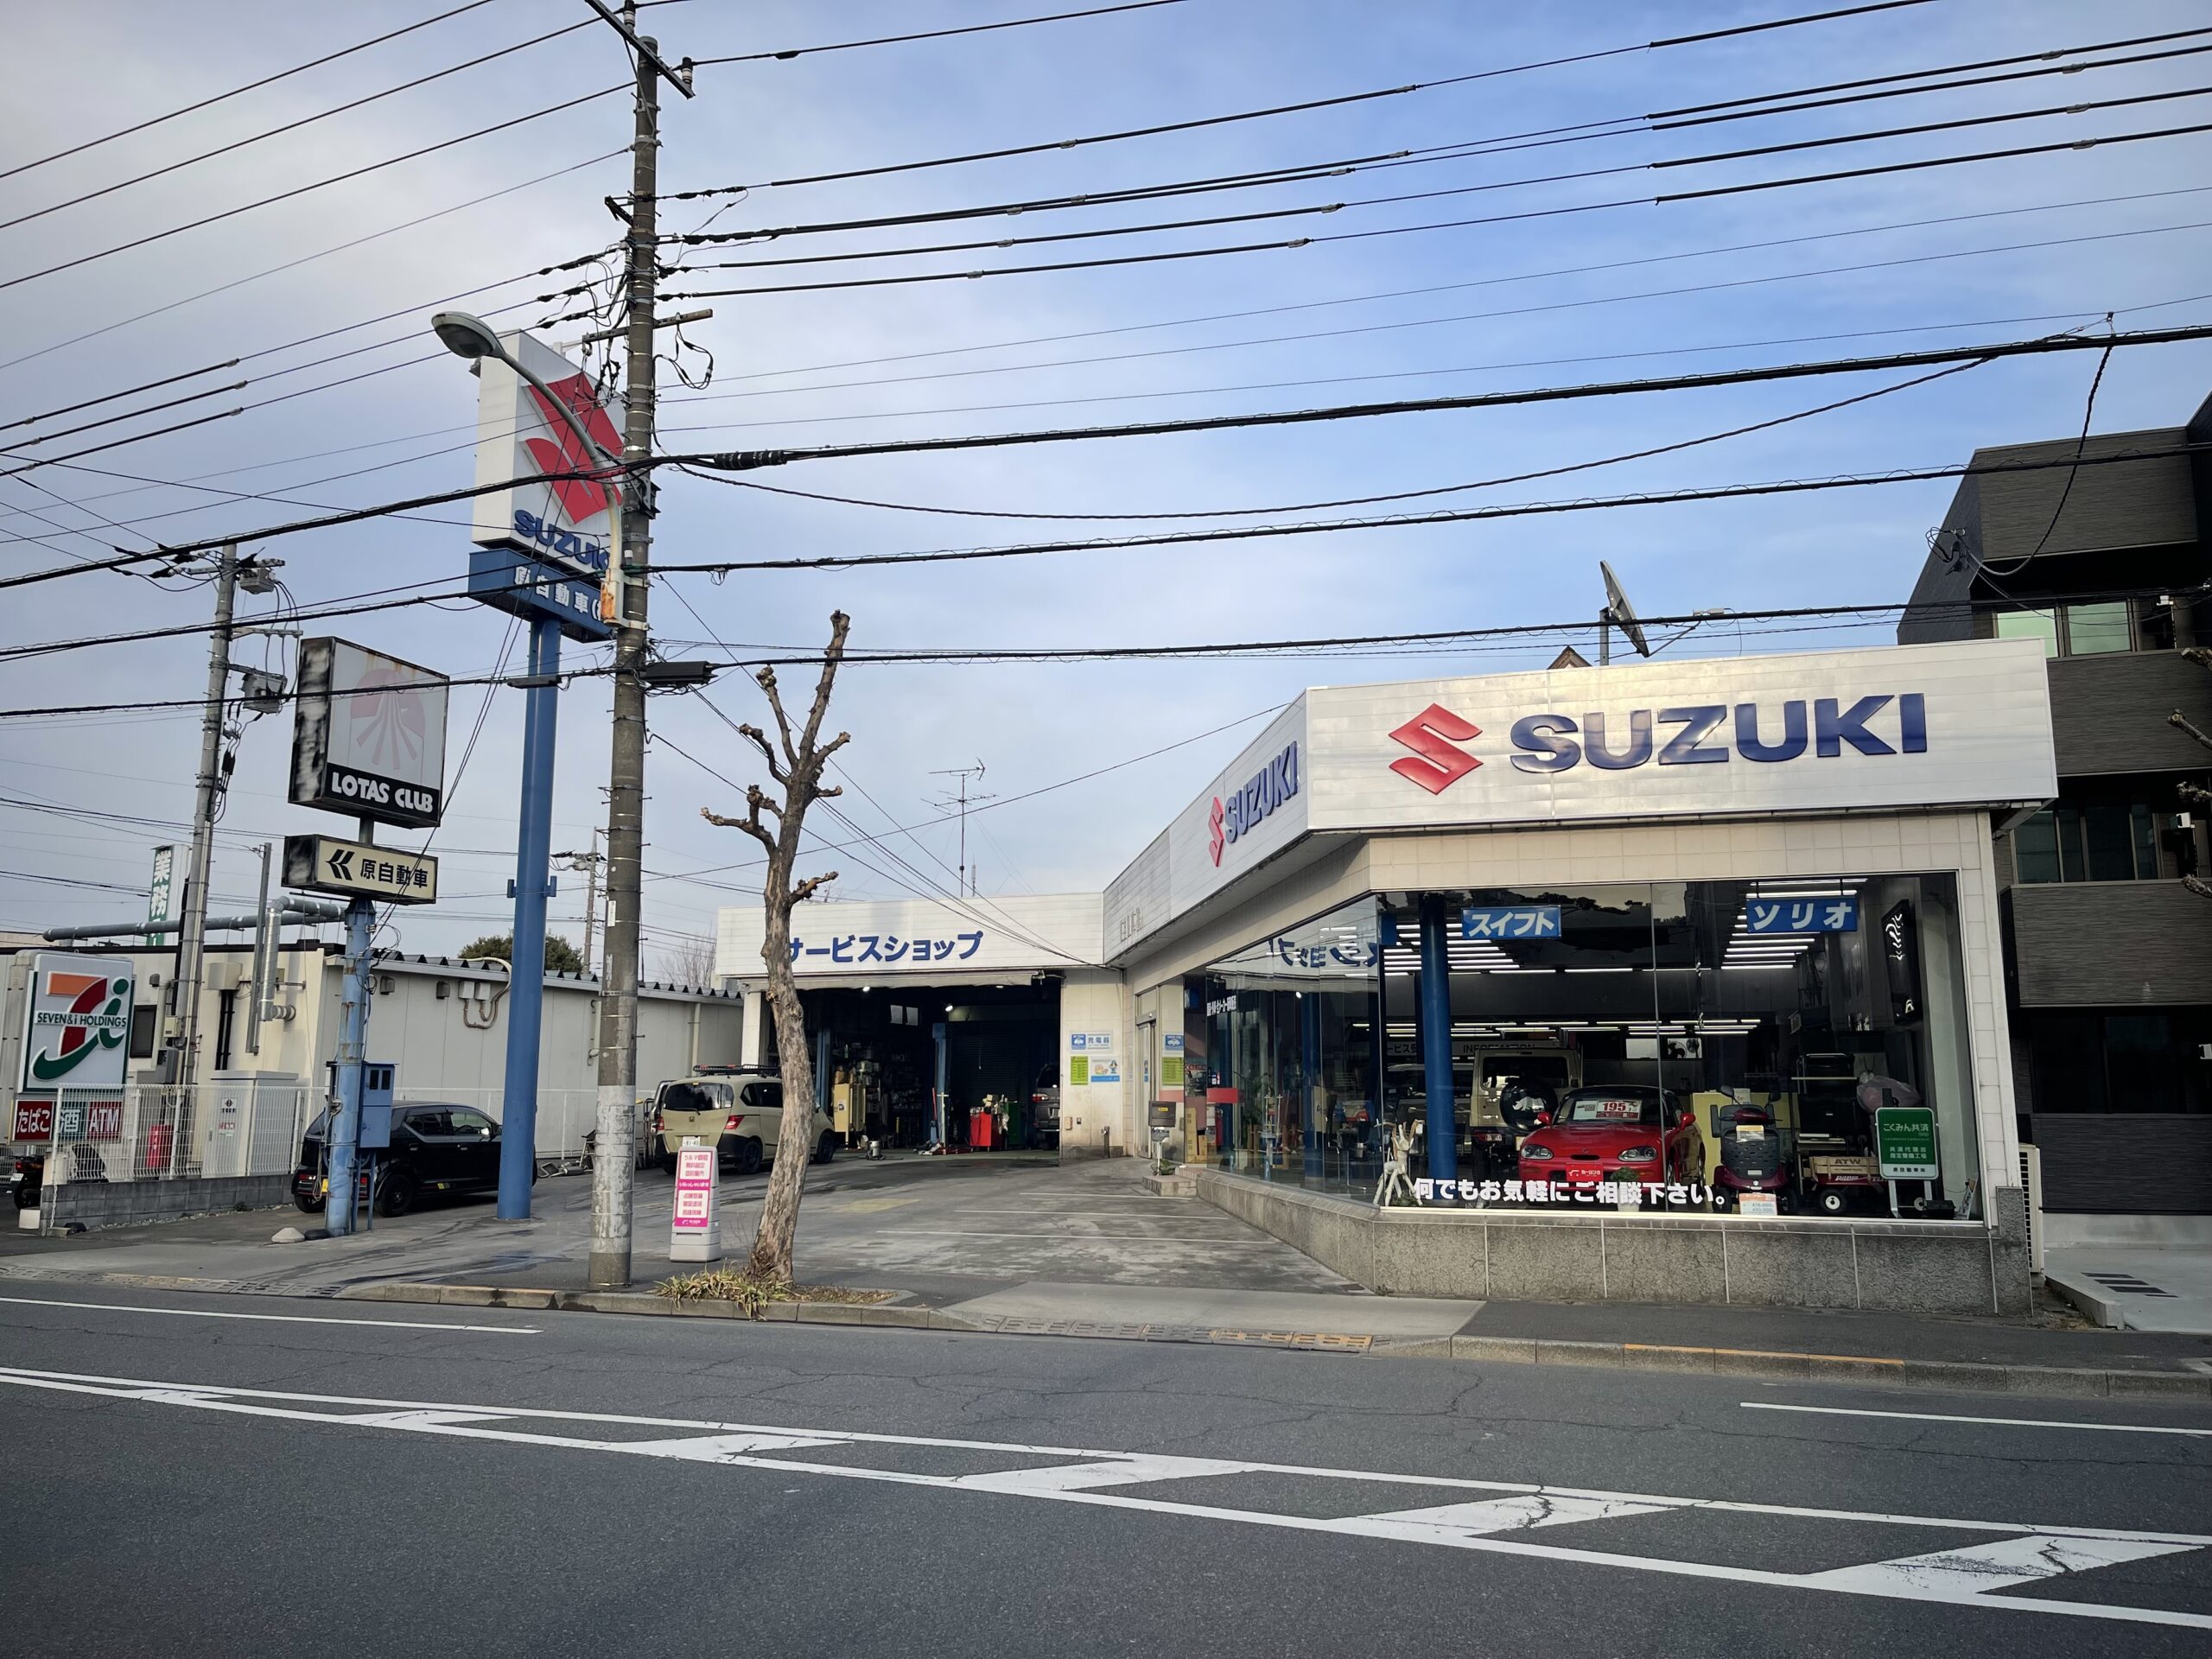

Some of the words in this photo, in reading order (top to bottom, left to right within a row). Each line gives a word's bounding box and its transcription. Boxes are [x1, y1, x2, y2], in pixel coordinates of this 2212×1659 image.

[513, 509, 610, 570] SUZUK
[1510, 692, 1928, 774] SUZUKI
[331, 772, 390, 804] LOTAS
[394, 788, 434, 813] CLUB
[1224, 740, 1300, 844] SUZUKI
[359, 858, 429, 889] 原自動車
[1467, 911, 1556, 938] スイフト
[1751, 902, 1853, 931] ソリオ
[79, 1014, 127, 1028] HOLDINGS
[16, 1107, 51, 1134] たばこ
[59, 1109, 81, 1134] 酒
[89, 1109, 119, 1133] ATM
[1883, 1122, 1929, 1132] こくみん共済
[1414, 1177, 1726, 1206] 何でもお気軽にご相談下さい。
